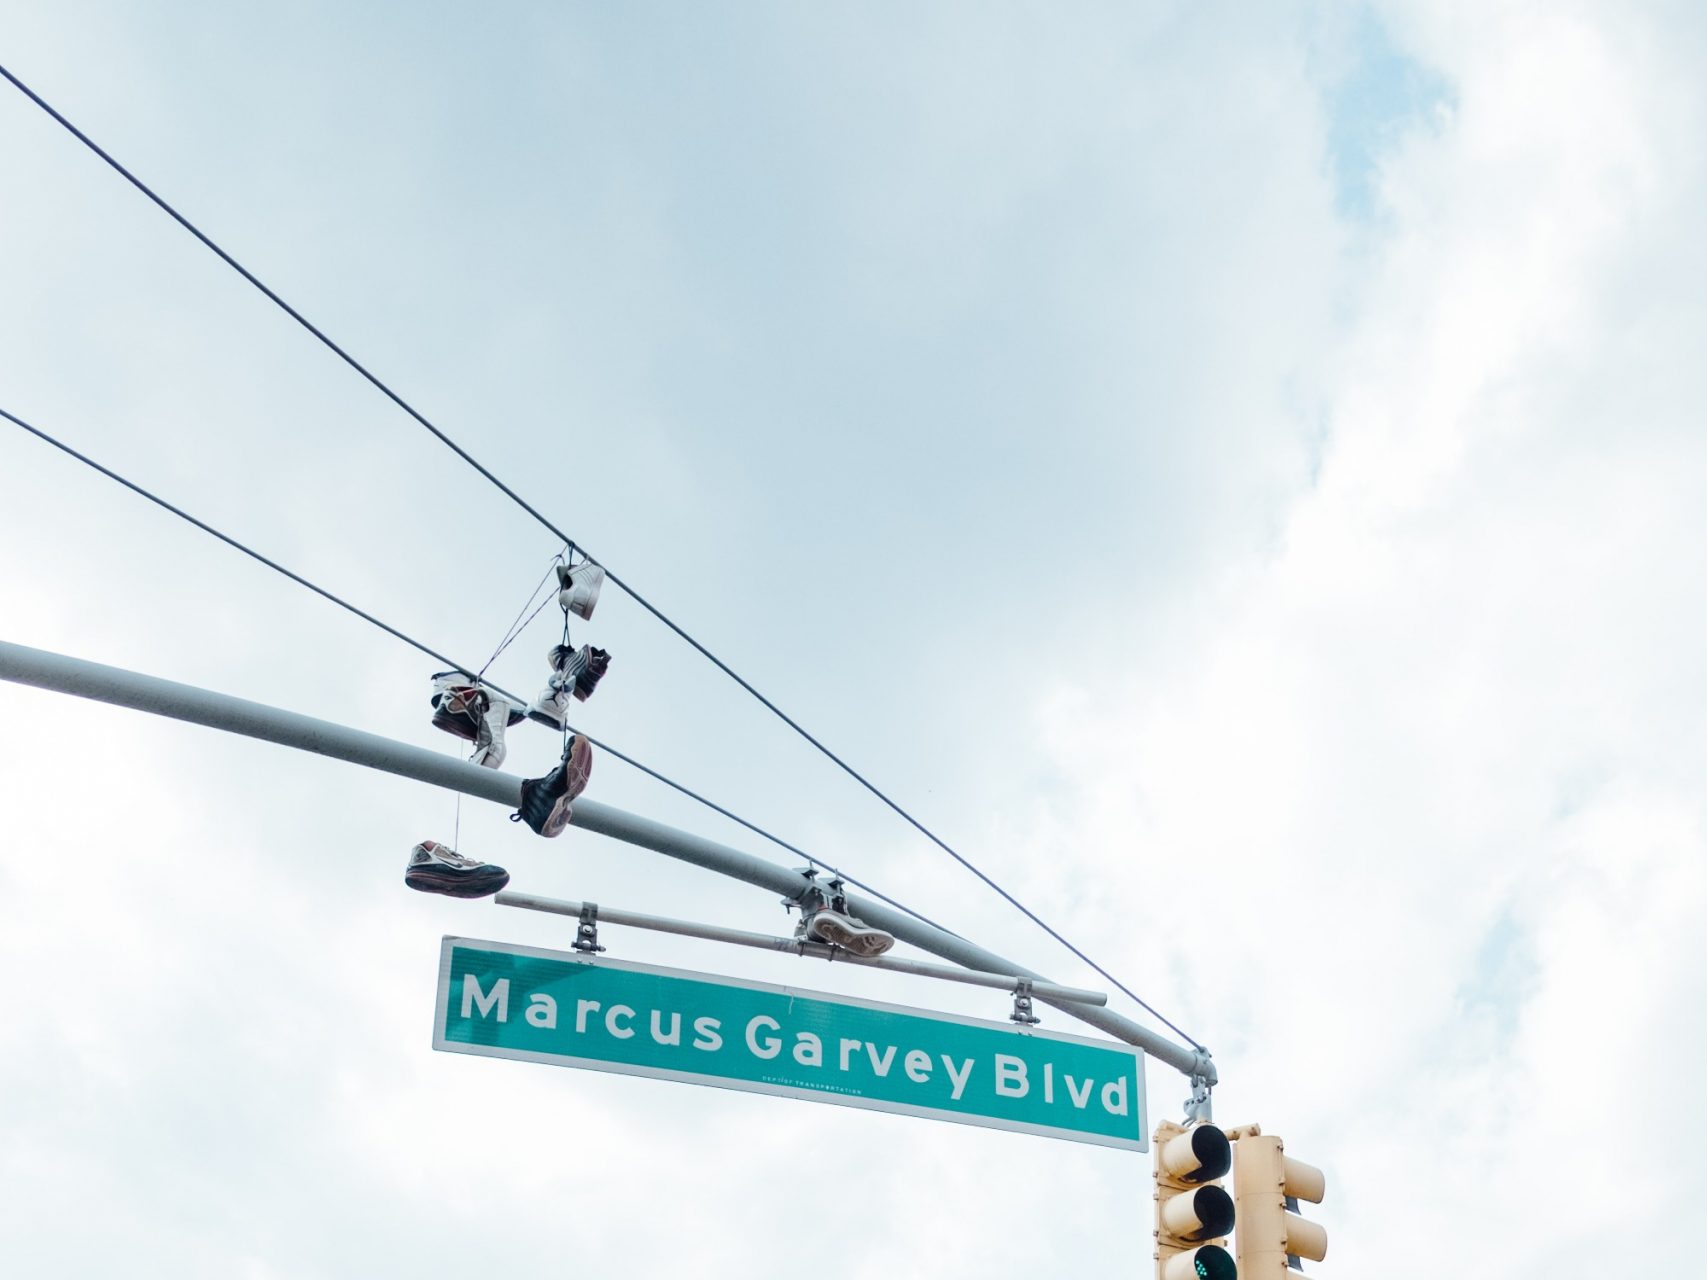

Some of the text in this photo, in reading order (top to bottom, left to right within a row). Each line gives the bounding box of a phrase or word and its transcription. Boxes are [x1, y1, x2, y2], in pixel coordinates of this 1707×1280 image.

[460, 973, 1130, 1117] Marcus Garvey Blvd
[795, 1080, 862, 1095] TRANSPORTATION
